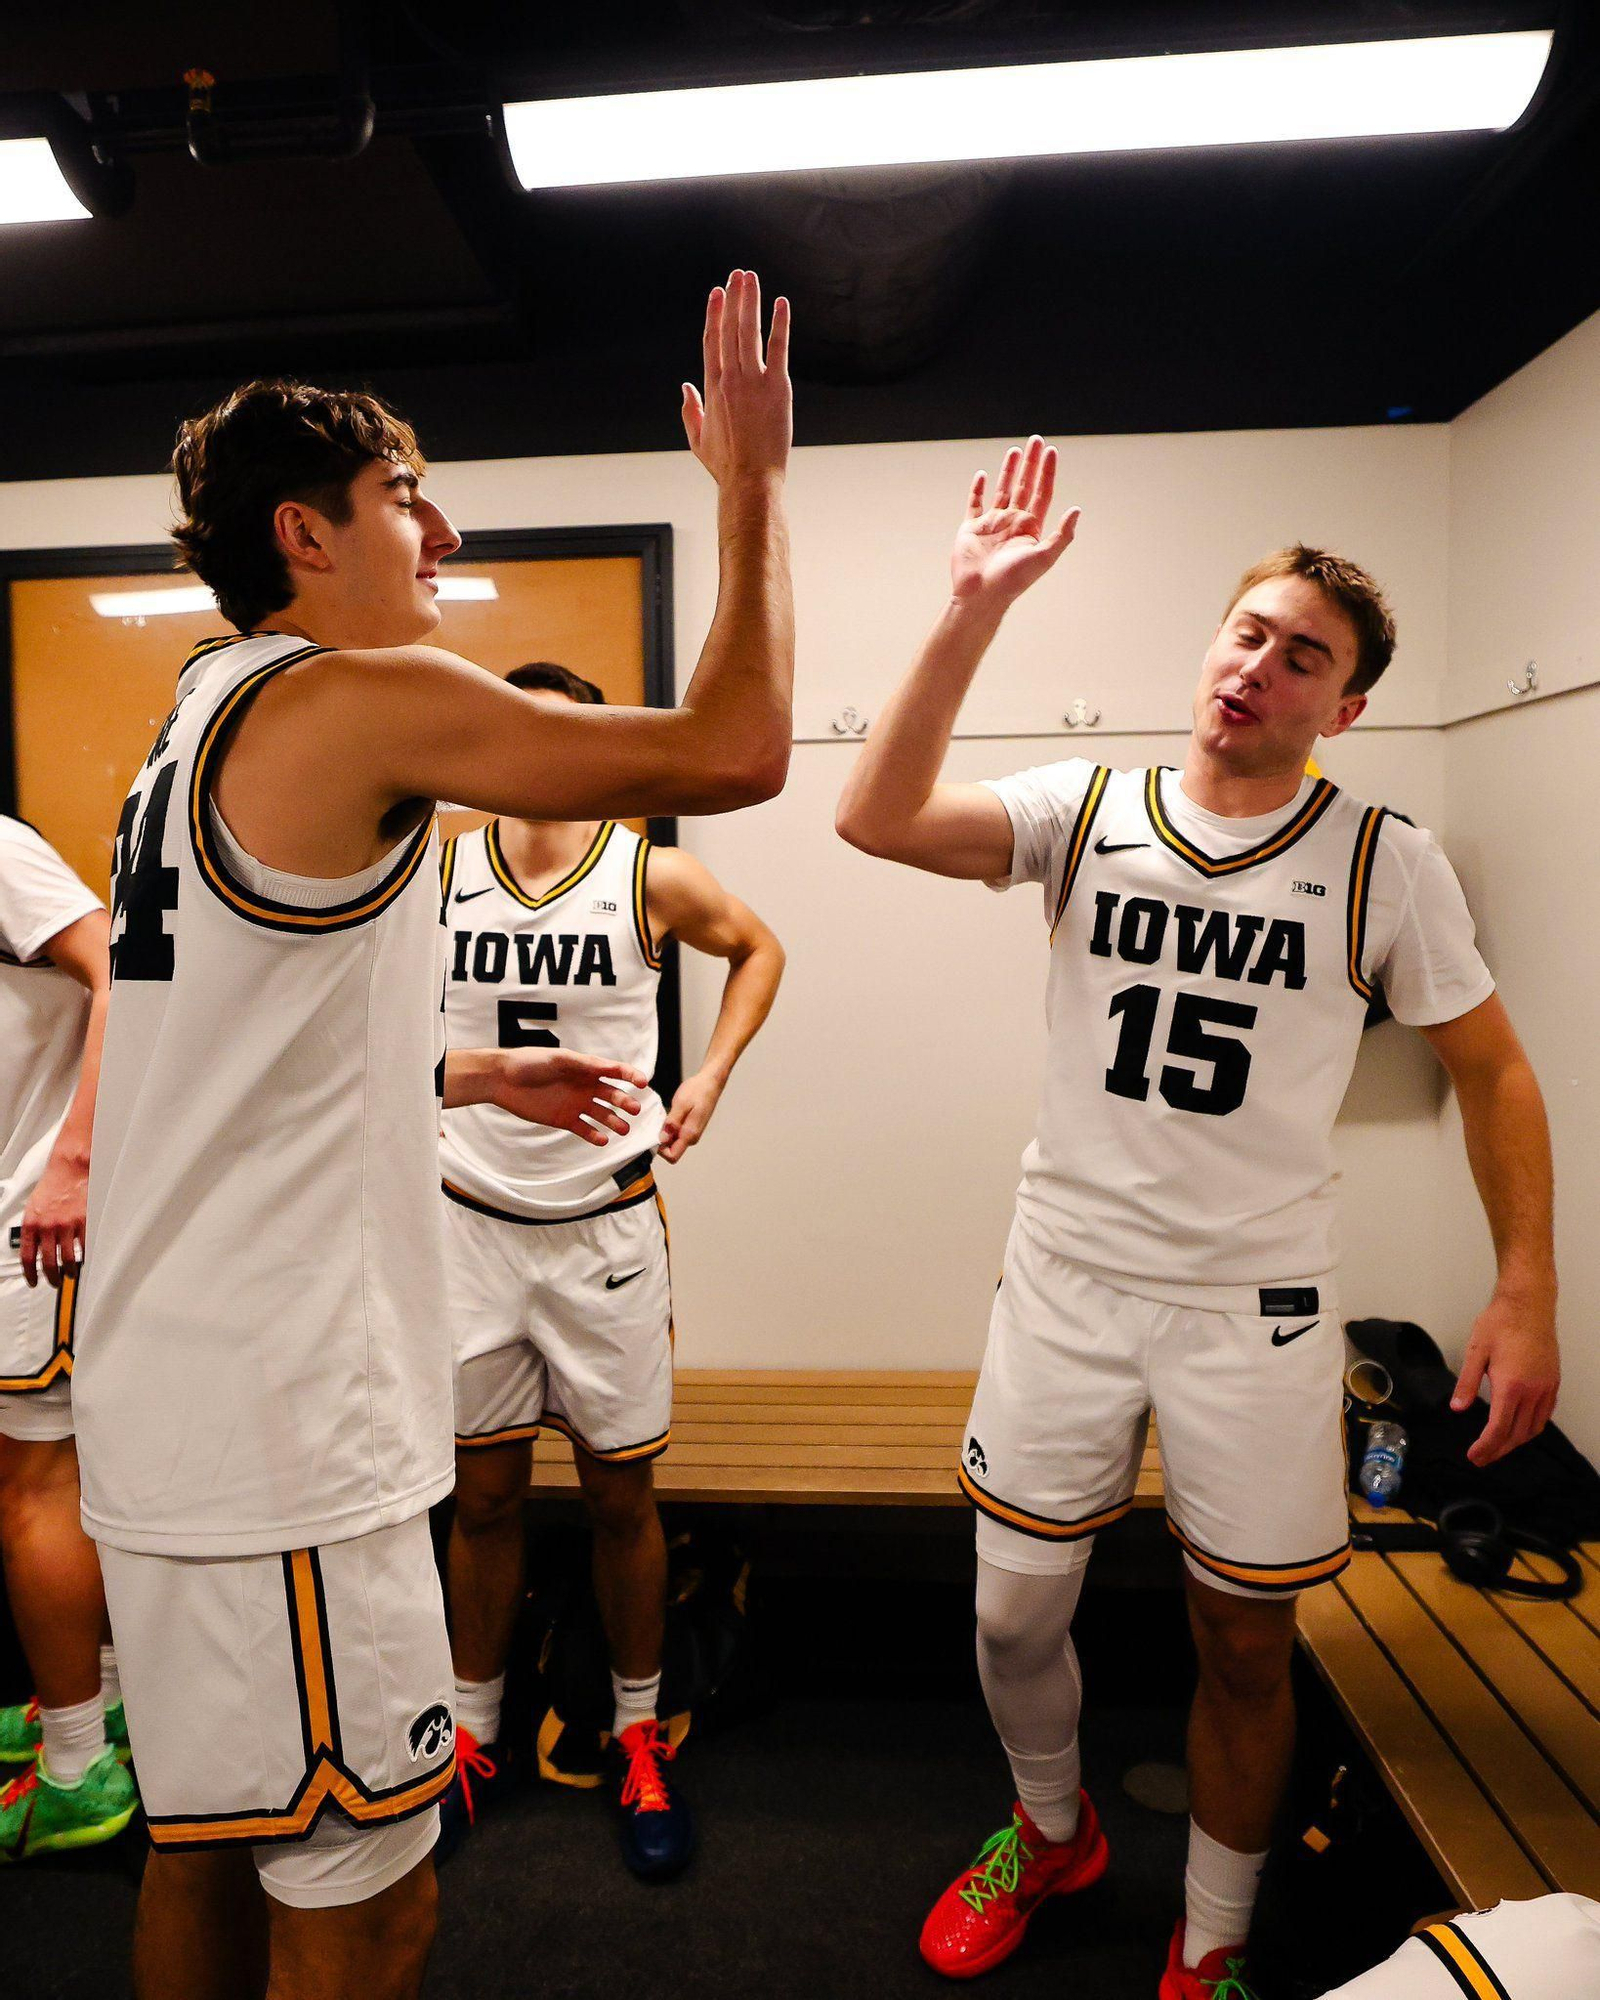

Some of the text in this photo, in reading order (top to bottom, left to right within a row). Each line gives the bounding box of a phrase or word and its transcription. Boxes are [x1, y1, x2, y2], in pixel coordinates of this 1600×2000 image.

[451, 930, 617, 986] IOWA
[1090, 890, 1308, 990] IOWA
[1104, 983, 1259, 1117] 15
